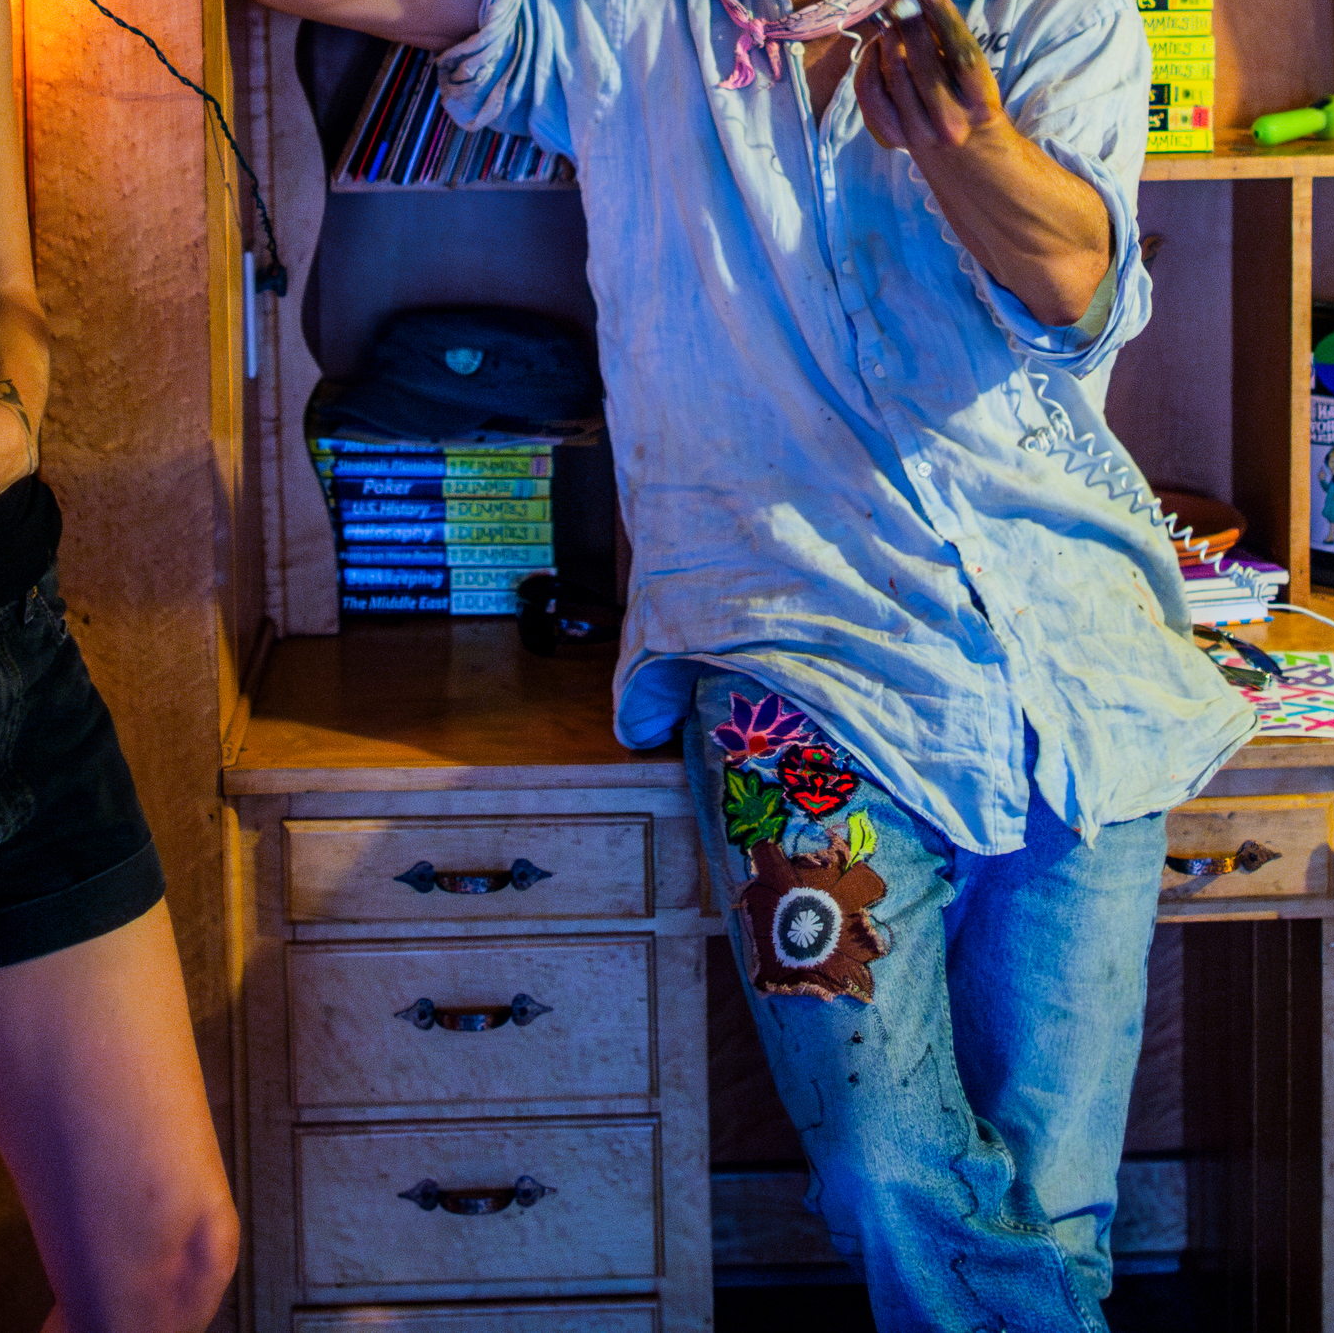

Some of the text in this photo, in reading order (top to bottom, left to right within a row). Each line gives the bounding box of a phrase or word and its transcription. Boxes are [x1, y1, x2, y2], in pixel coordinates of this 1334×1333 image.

[362, 478, 512, 495] Poker DUMMIE
[379, 500, 431, 519] History
[458, 502, 528, 517] DUMMIES
[458, 525, 528, 540] DUMMIES
[461, 548, 530, 563] DUMMIES
[343, 596, 367, 610] The
[369, 595, 417, 610] Middle
[418, 595, 450, 610] East
